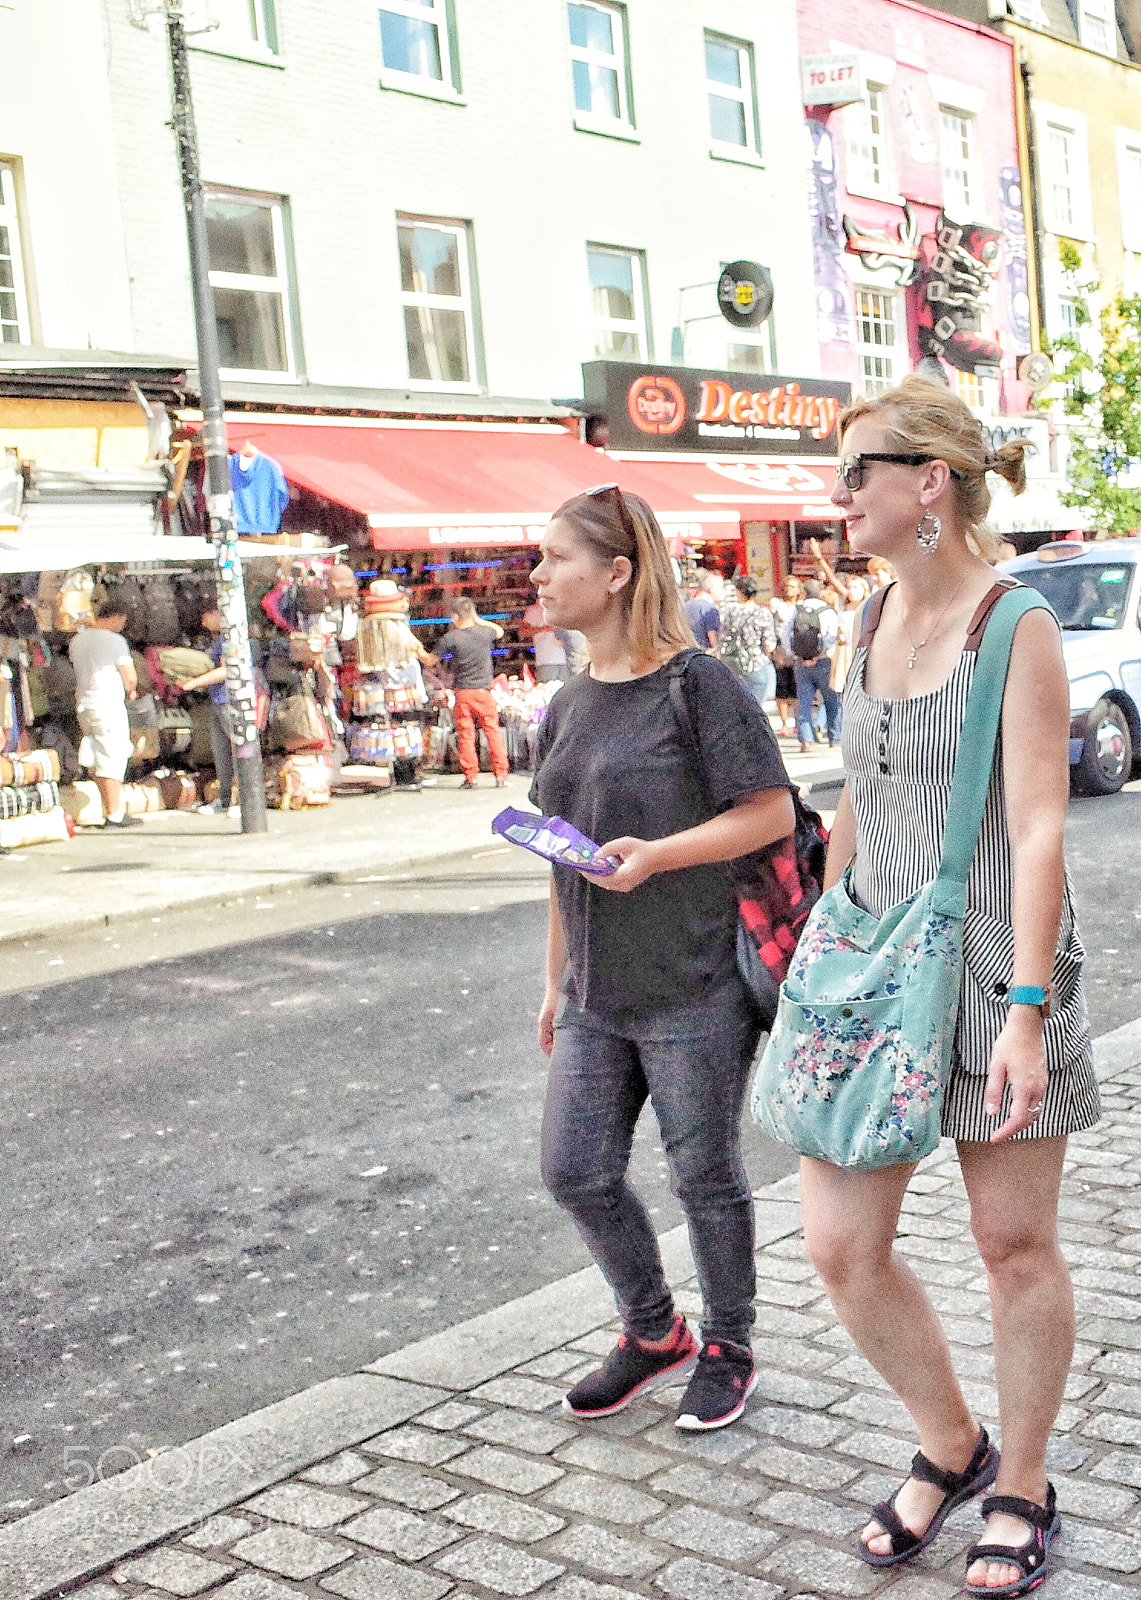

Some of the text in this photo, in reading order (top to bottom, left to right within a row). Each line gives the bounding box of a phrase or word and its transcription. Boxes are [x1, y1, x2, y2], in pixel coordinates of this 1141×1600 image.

[810, 65, 854, 86] TO LET
[695, 380, 840, 440] Destiny
